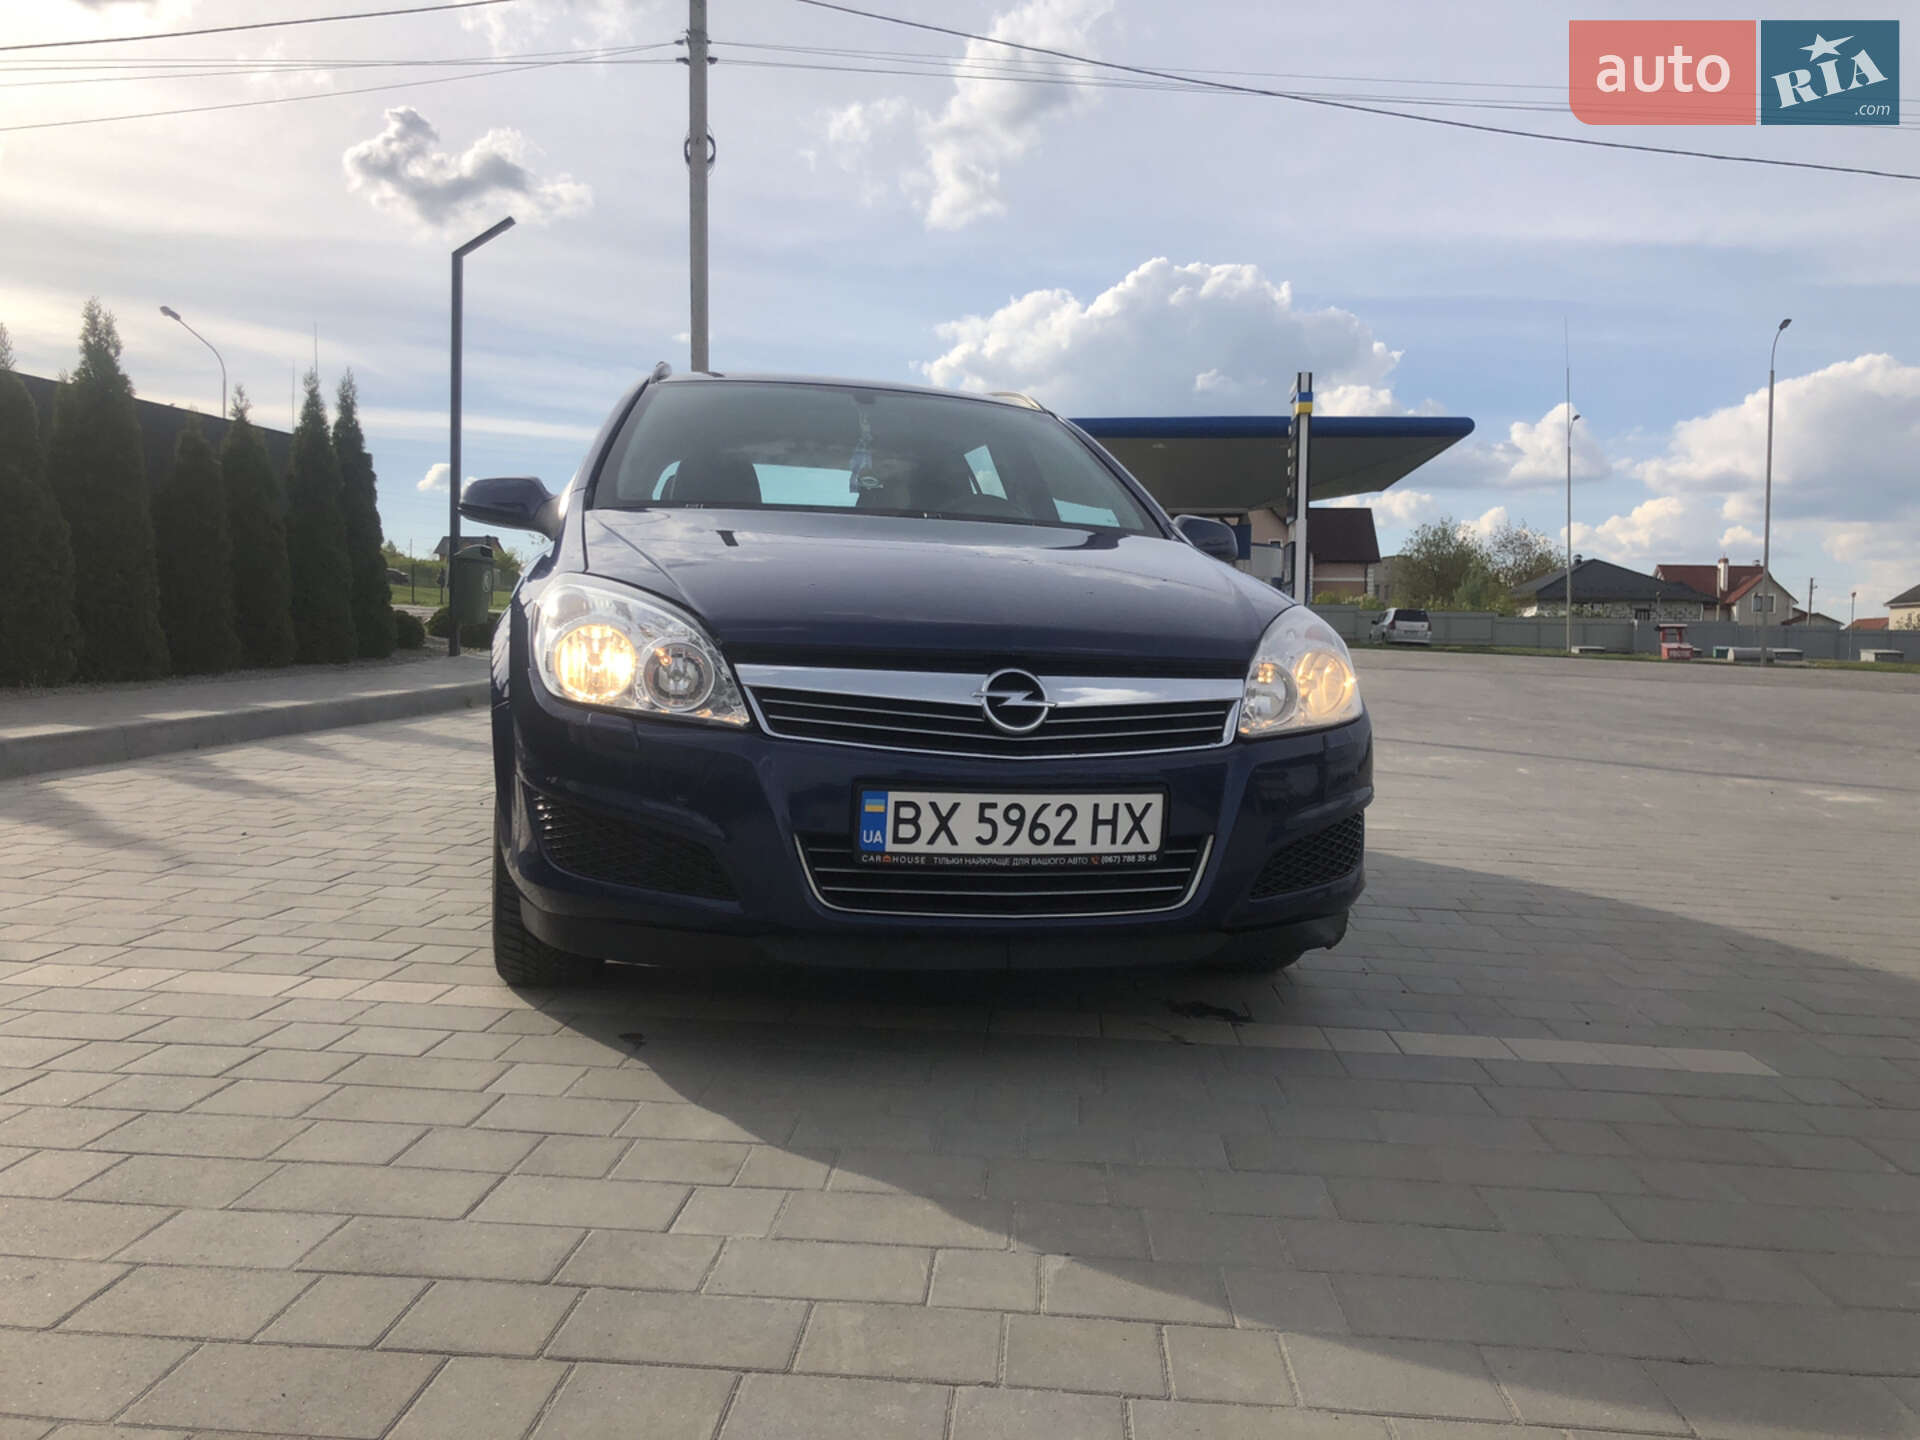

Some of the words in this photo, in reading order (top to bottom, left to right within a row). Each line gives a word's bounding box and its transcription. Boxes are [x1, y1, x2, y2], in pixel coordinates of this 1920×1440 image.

[891, 800, 961, 846] BX
[975, 802, 1078, 846] 5962
[1090, 802, 1153, 846] HX
[863, 830, 883, 844] UA
[862, 854, 881, 863] CAR
[892, 855, 926, 865] HOUSE
[1012, 856, 1030, 866] ДЛЯ
[1031, 856, 1066, 865] ВАШОГО
[1067, 855, 1088, 865] АВТО
